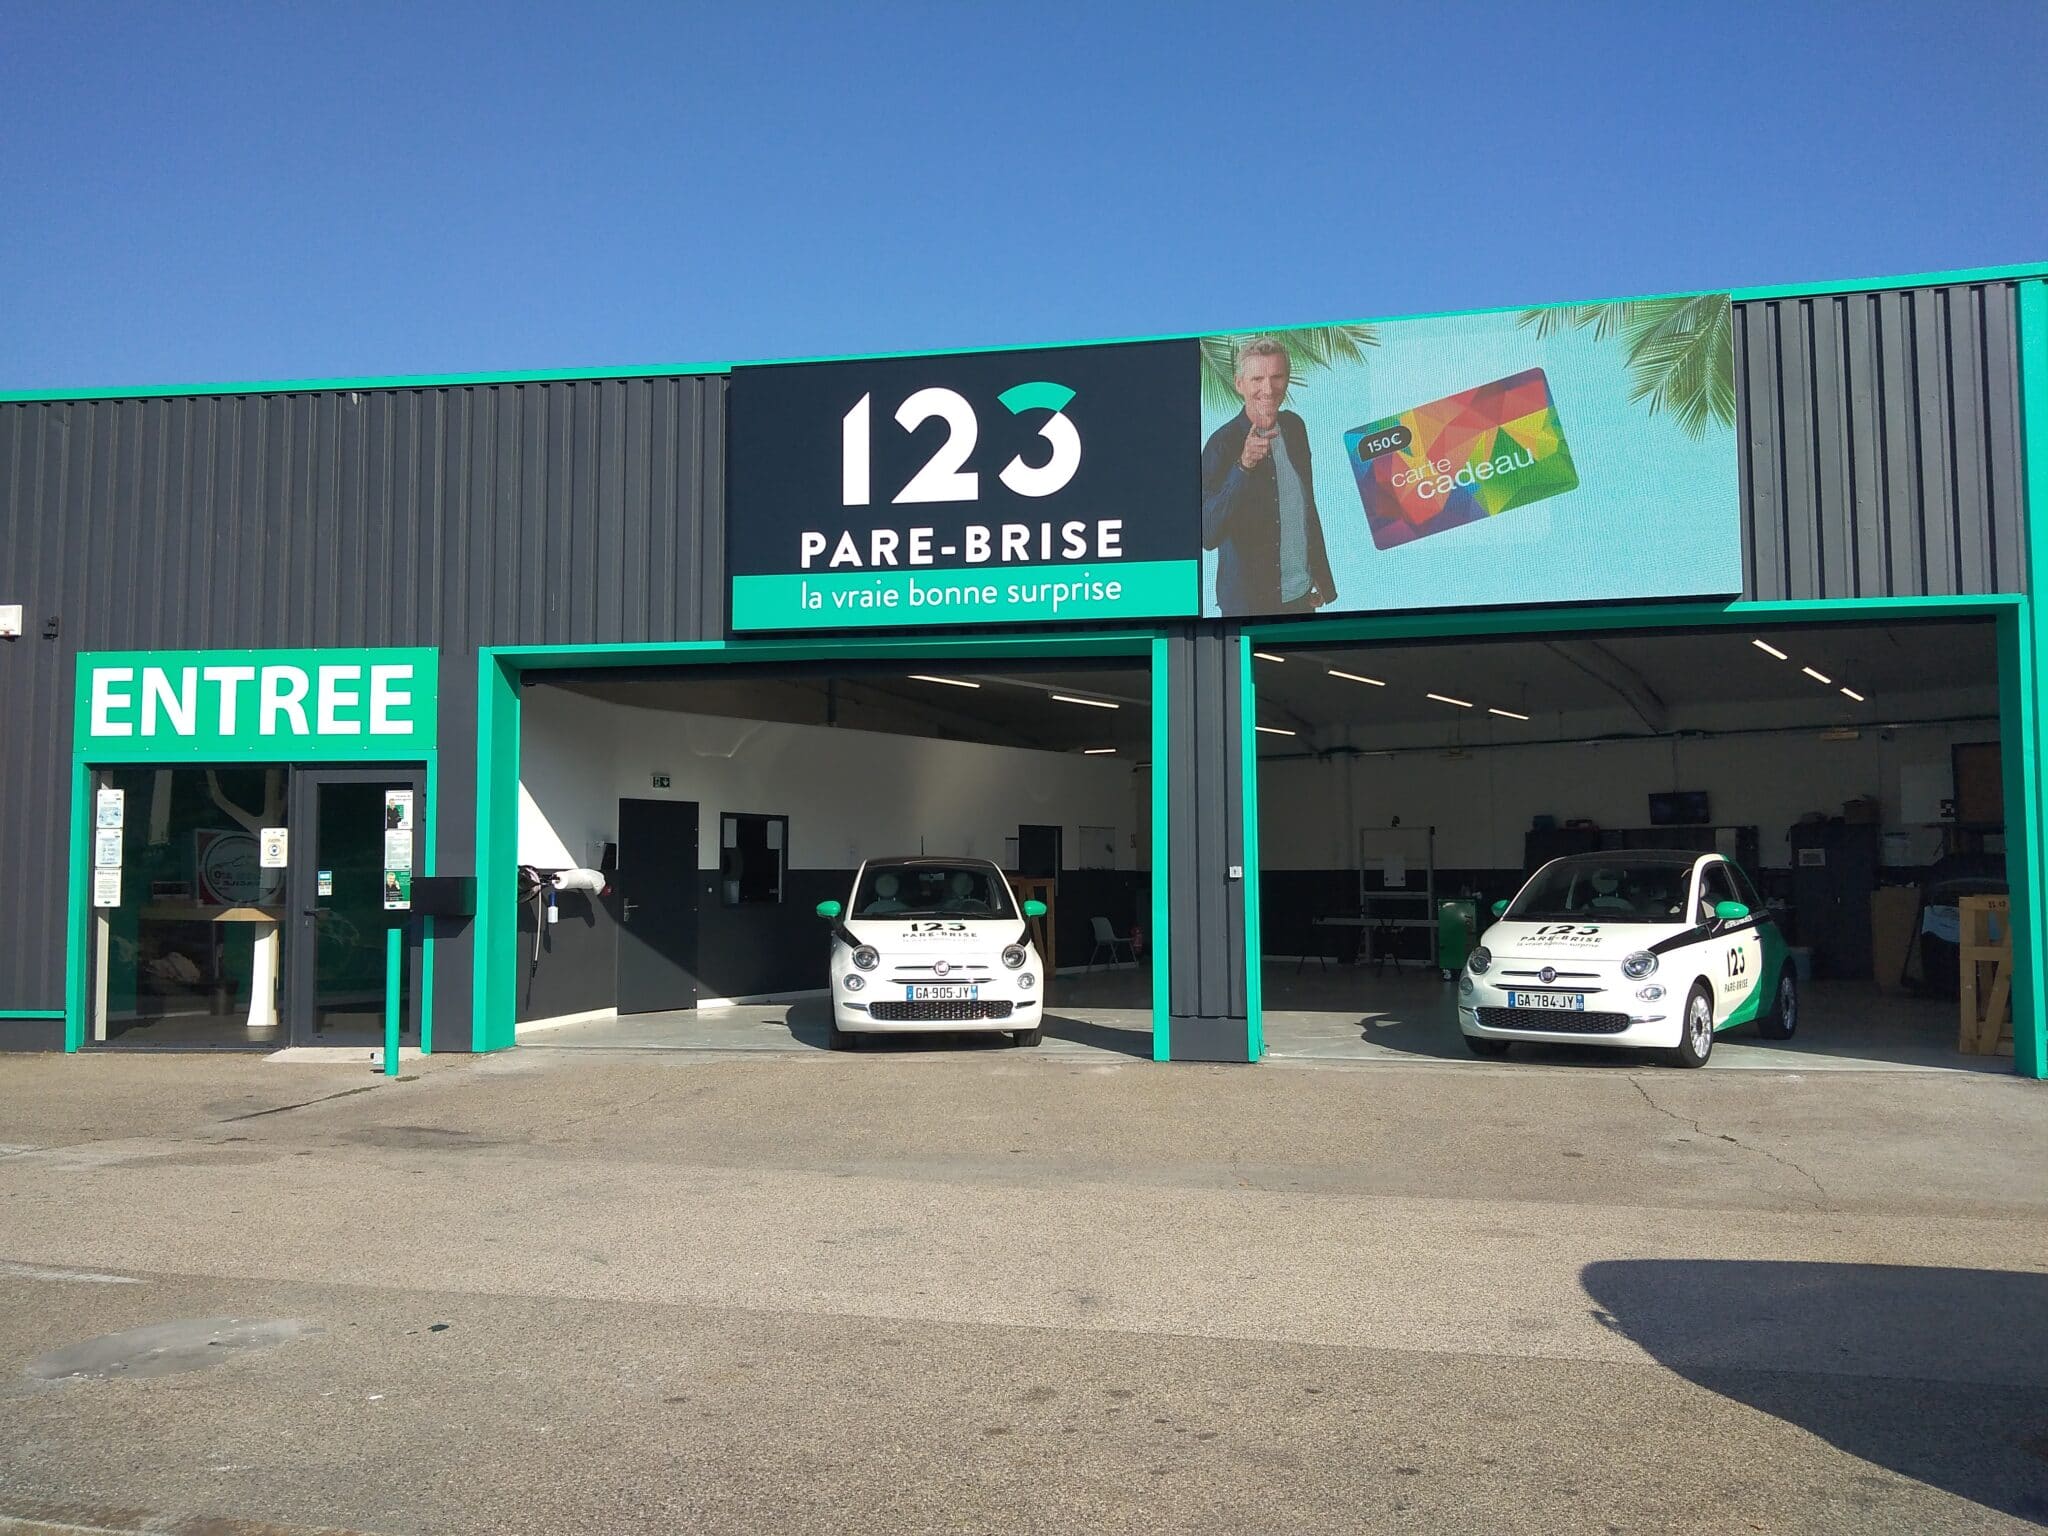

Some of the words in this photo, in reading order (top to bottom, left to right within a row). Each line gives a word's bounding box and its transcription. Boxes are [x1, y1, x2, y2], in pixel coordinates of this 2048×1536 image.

[843, 381, 1082, 506] 123
[1391, 457, 1452, 488] carte
[1416, 447, 1535, 500] cadeau
[800, 519, 1123, 569] PARE-BRISE
[801, 580, 823, 610] la
[831, 578, 899, 609] vraie
[909, 577, 998, 608] bonne
[1007, 571, 1122, 613] surprise
[90, 664, 414, 737] ENTREE
[911, 922, 967, 932] 123
[1535, 925, 1600, 935] 123
[1726, 946, 1745, 977] 123
[916, 987, 969, 999] GA-905-JY
[1517, 994, 1574, 1008] GA-784-JY
